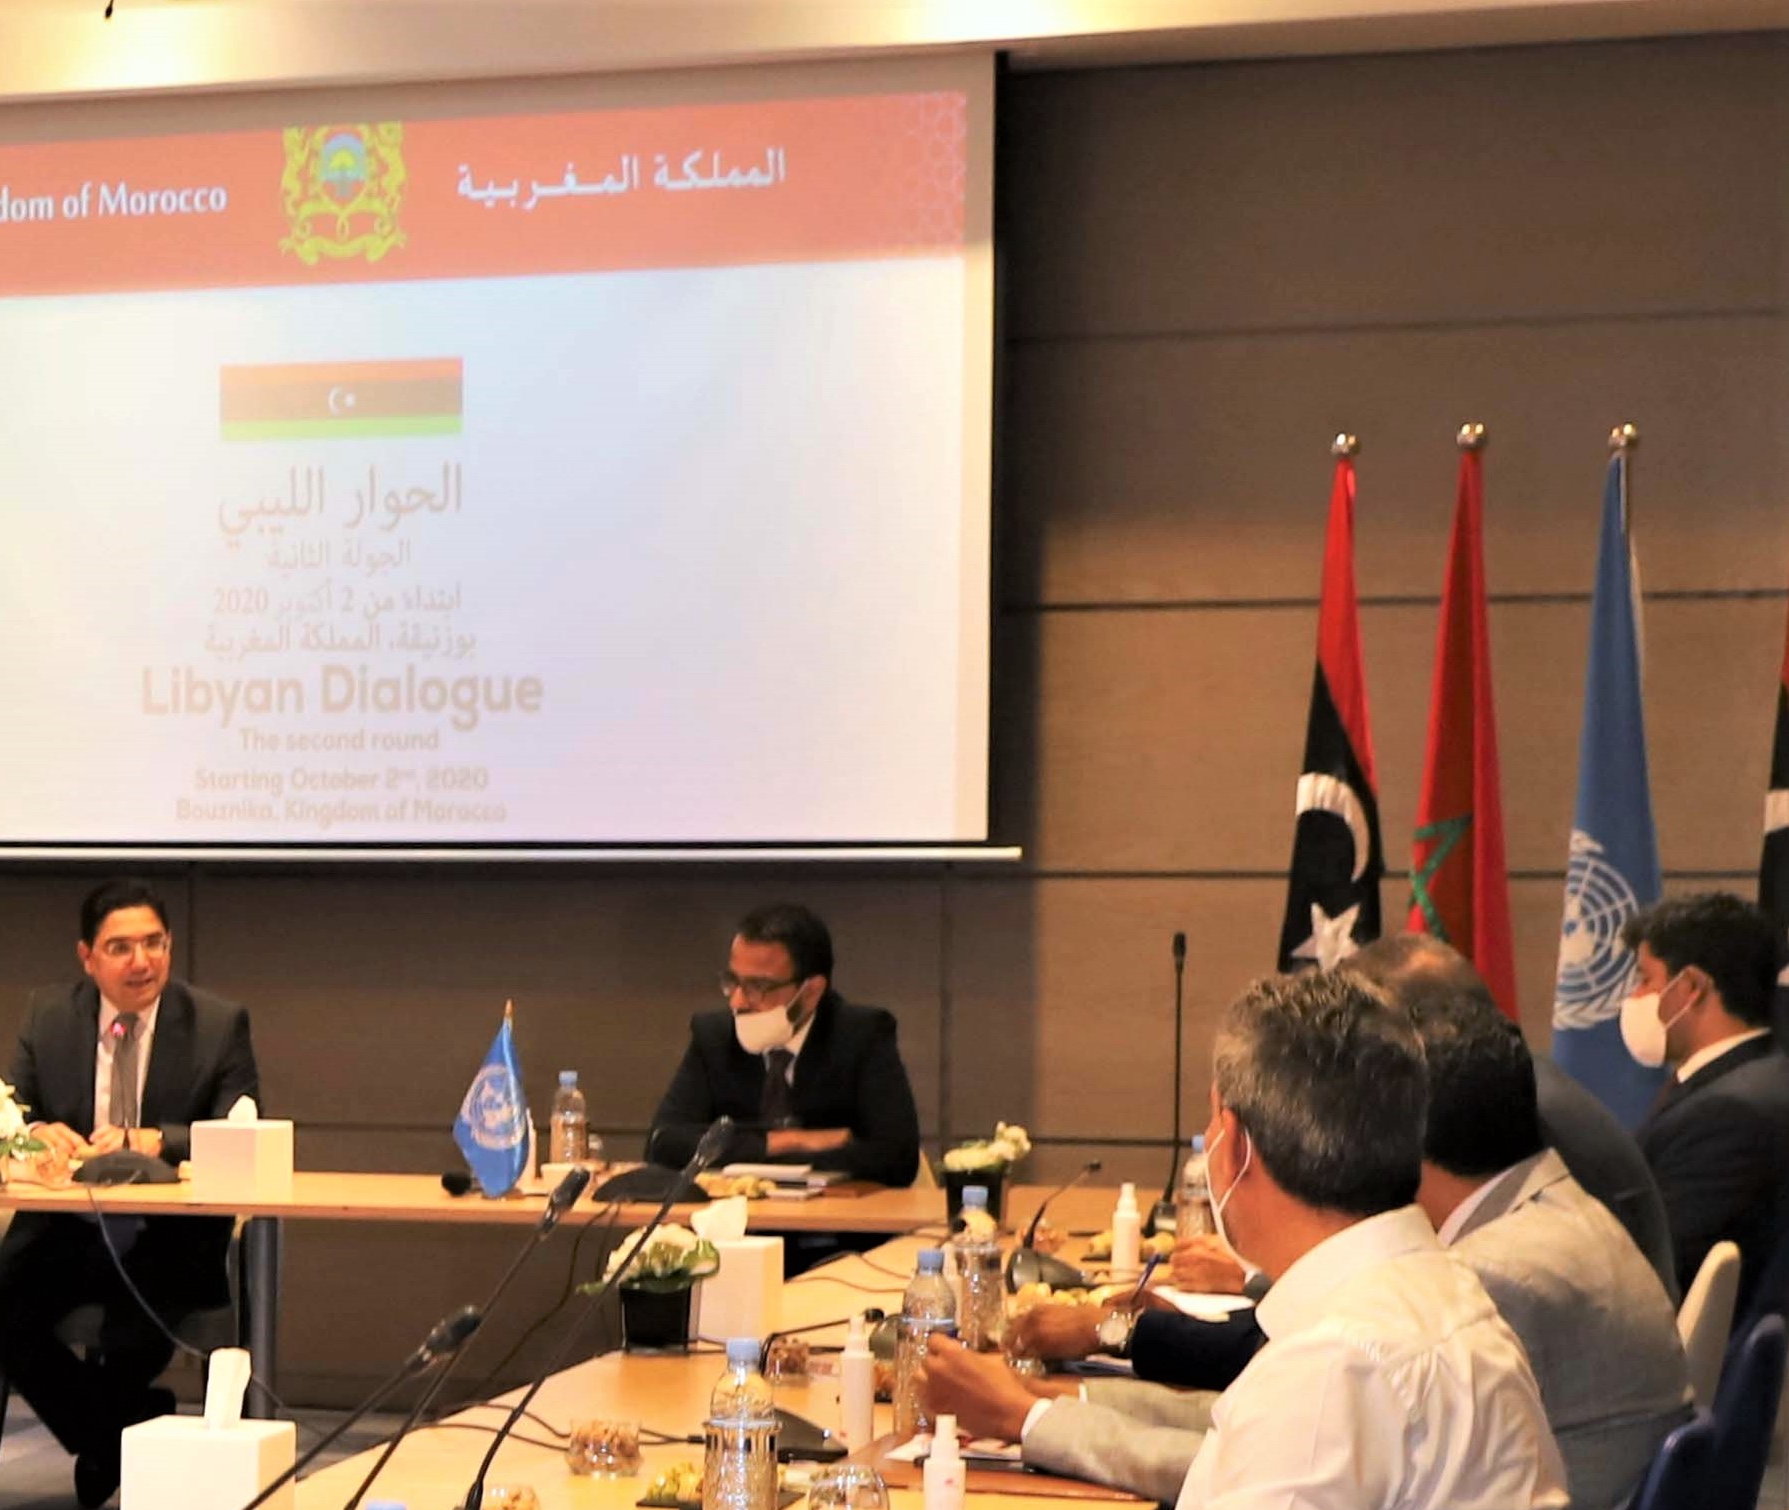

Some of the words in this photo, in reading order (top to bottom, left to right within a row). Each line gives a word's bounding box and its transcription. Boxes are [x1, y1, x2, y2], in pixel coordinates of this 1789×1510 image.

[458, 154, 639, 211] المغربية
[653, 147, 786, 190] المملكة
[62, 181, 92, 220] of
[98, 180, 228, 217] Morocco
[218, 463, 325, 554] الليبي
[343, 460, 462, 531] الحوار
[214, 586, 269, 612] 2020
[342, 586, 355, 611] 2
[141, 664, 304, 729] Libyan
[320, 663, 544, 732] Dialogue
[238, 728, 279, 751] The
[286, 728, 365, 751] second
[370, 728, 441, 751] round
[193, 767, 283, 796] Starting
[290, 766, 379, 790] October
[425, 765, 490, 790] 2020
[285, 798, 379, 830] Kingdom
[385, 797, 408, 823] of
[413, 799, 508, 824] Morocco
